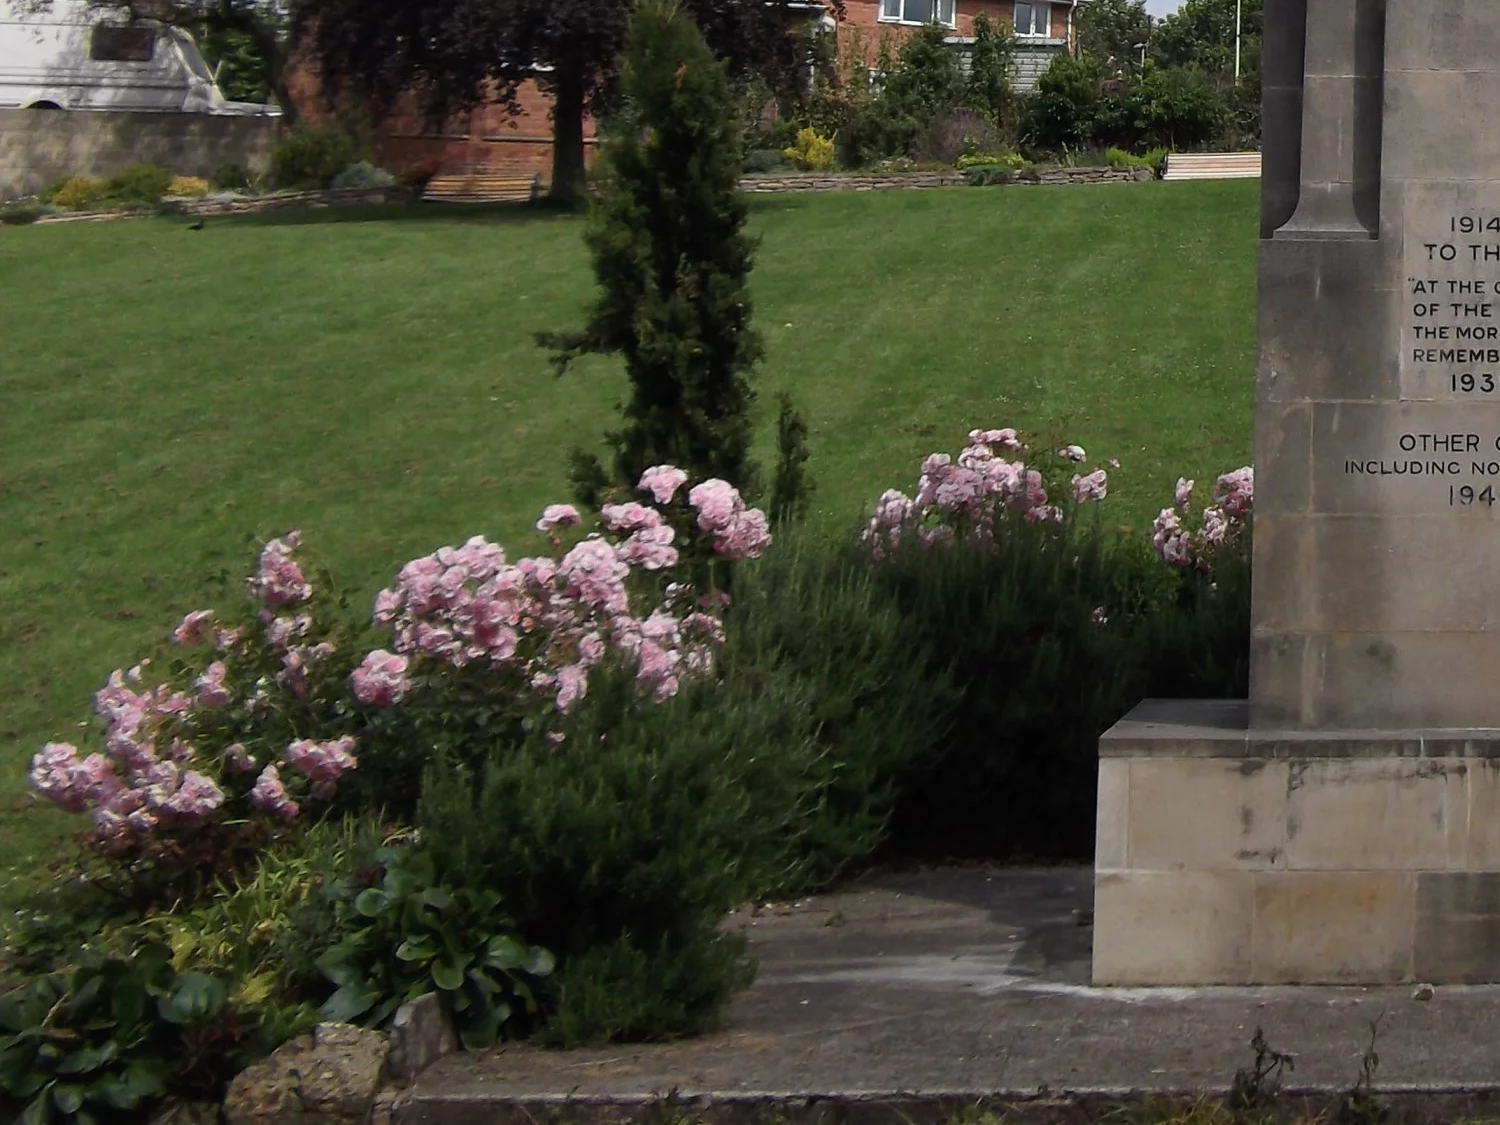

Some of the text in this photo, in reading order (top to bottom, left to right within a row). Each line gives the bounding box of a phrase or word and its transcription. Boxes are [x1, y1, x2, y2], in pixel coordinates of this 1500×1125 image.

[1423, 242, 1457, 262] TO
[1446, 279, 1486, 295] THE
[1412, 302, 1440, 318] OF
[1450, 303, 1493, 318] THE
[1412, 326, 1450, 340] THE
[1399, 434, 1481, 453] OTHER
[1344, 460, 1461, 475] INCLUDING
